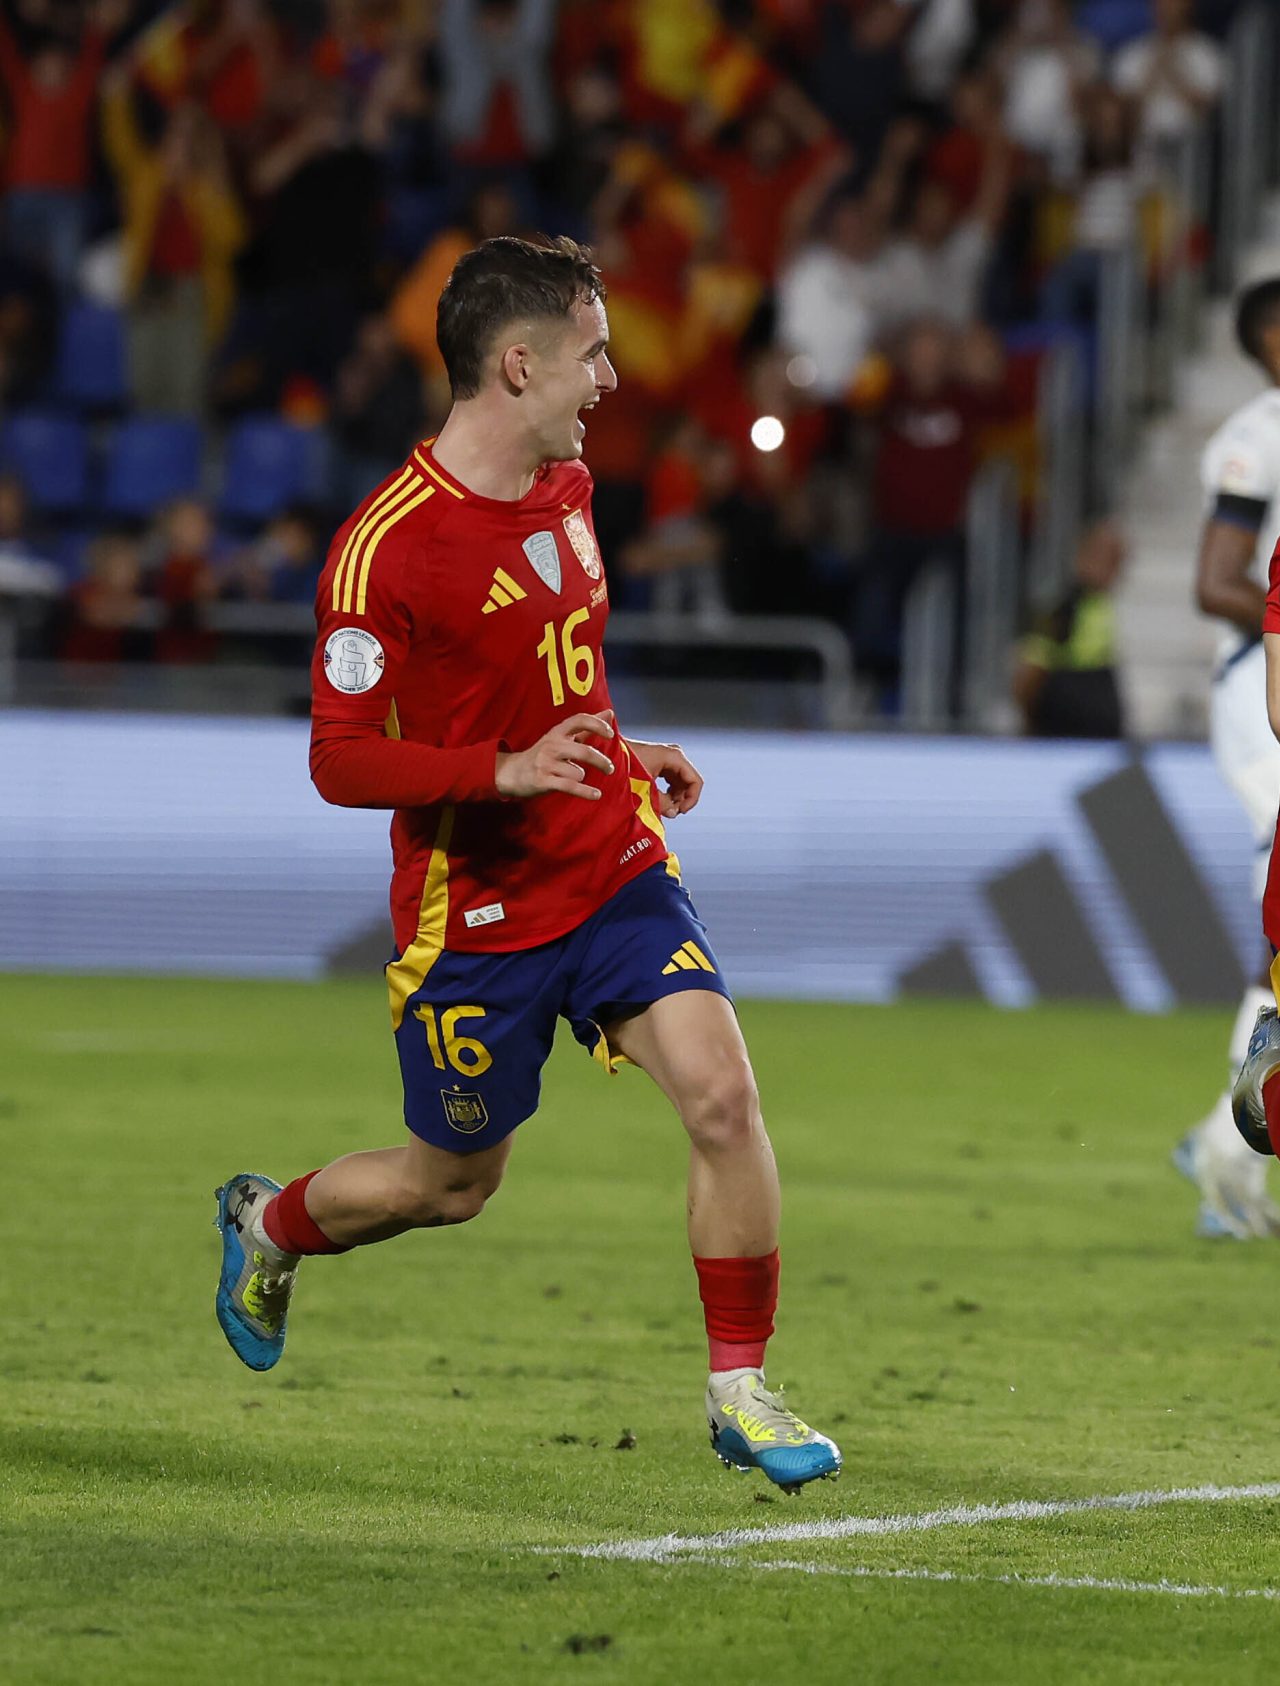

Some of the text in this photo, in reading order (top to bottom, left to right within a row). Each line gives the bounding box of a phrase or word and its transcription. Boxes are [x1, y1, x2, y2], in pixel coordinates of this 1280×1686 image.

[359, 631, 376, 645] LEAGUE
[537, 606, 594, 706] 16
[413, 1003, 493, 1077] 16
